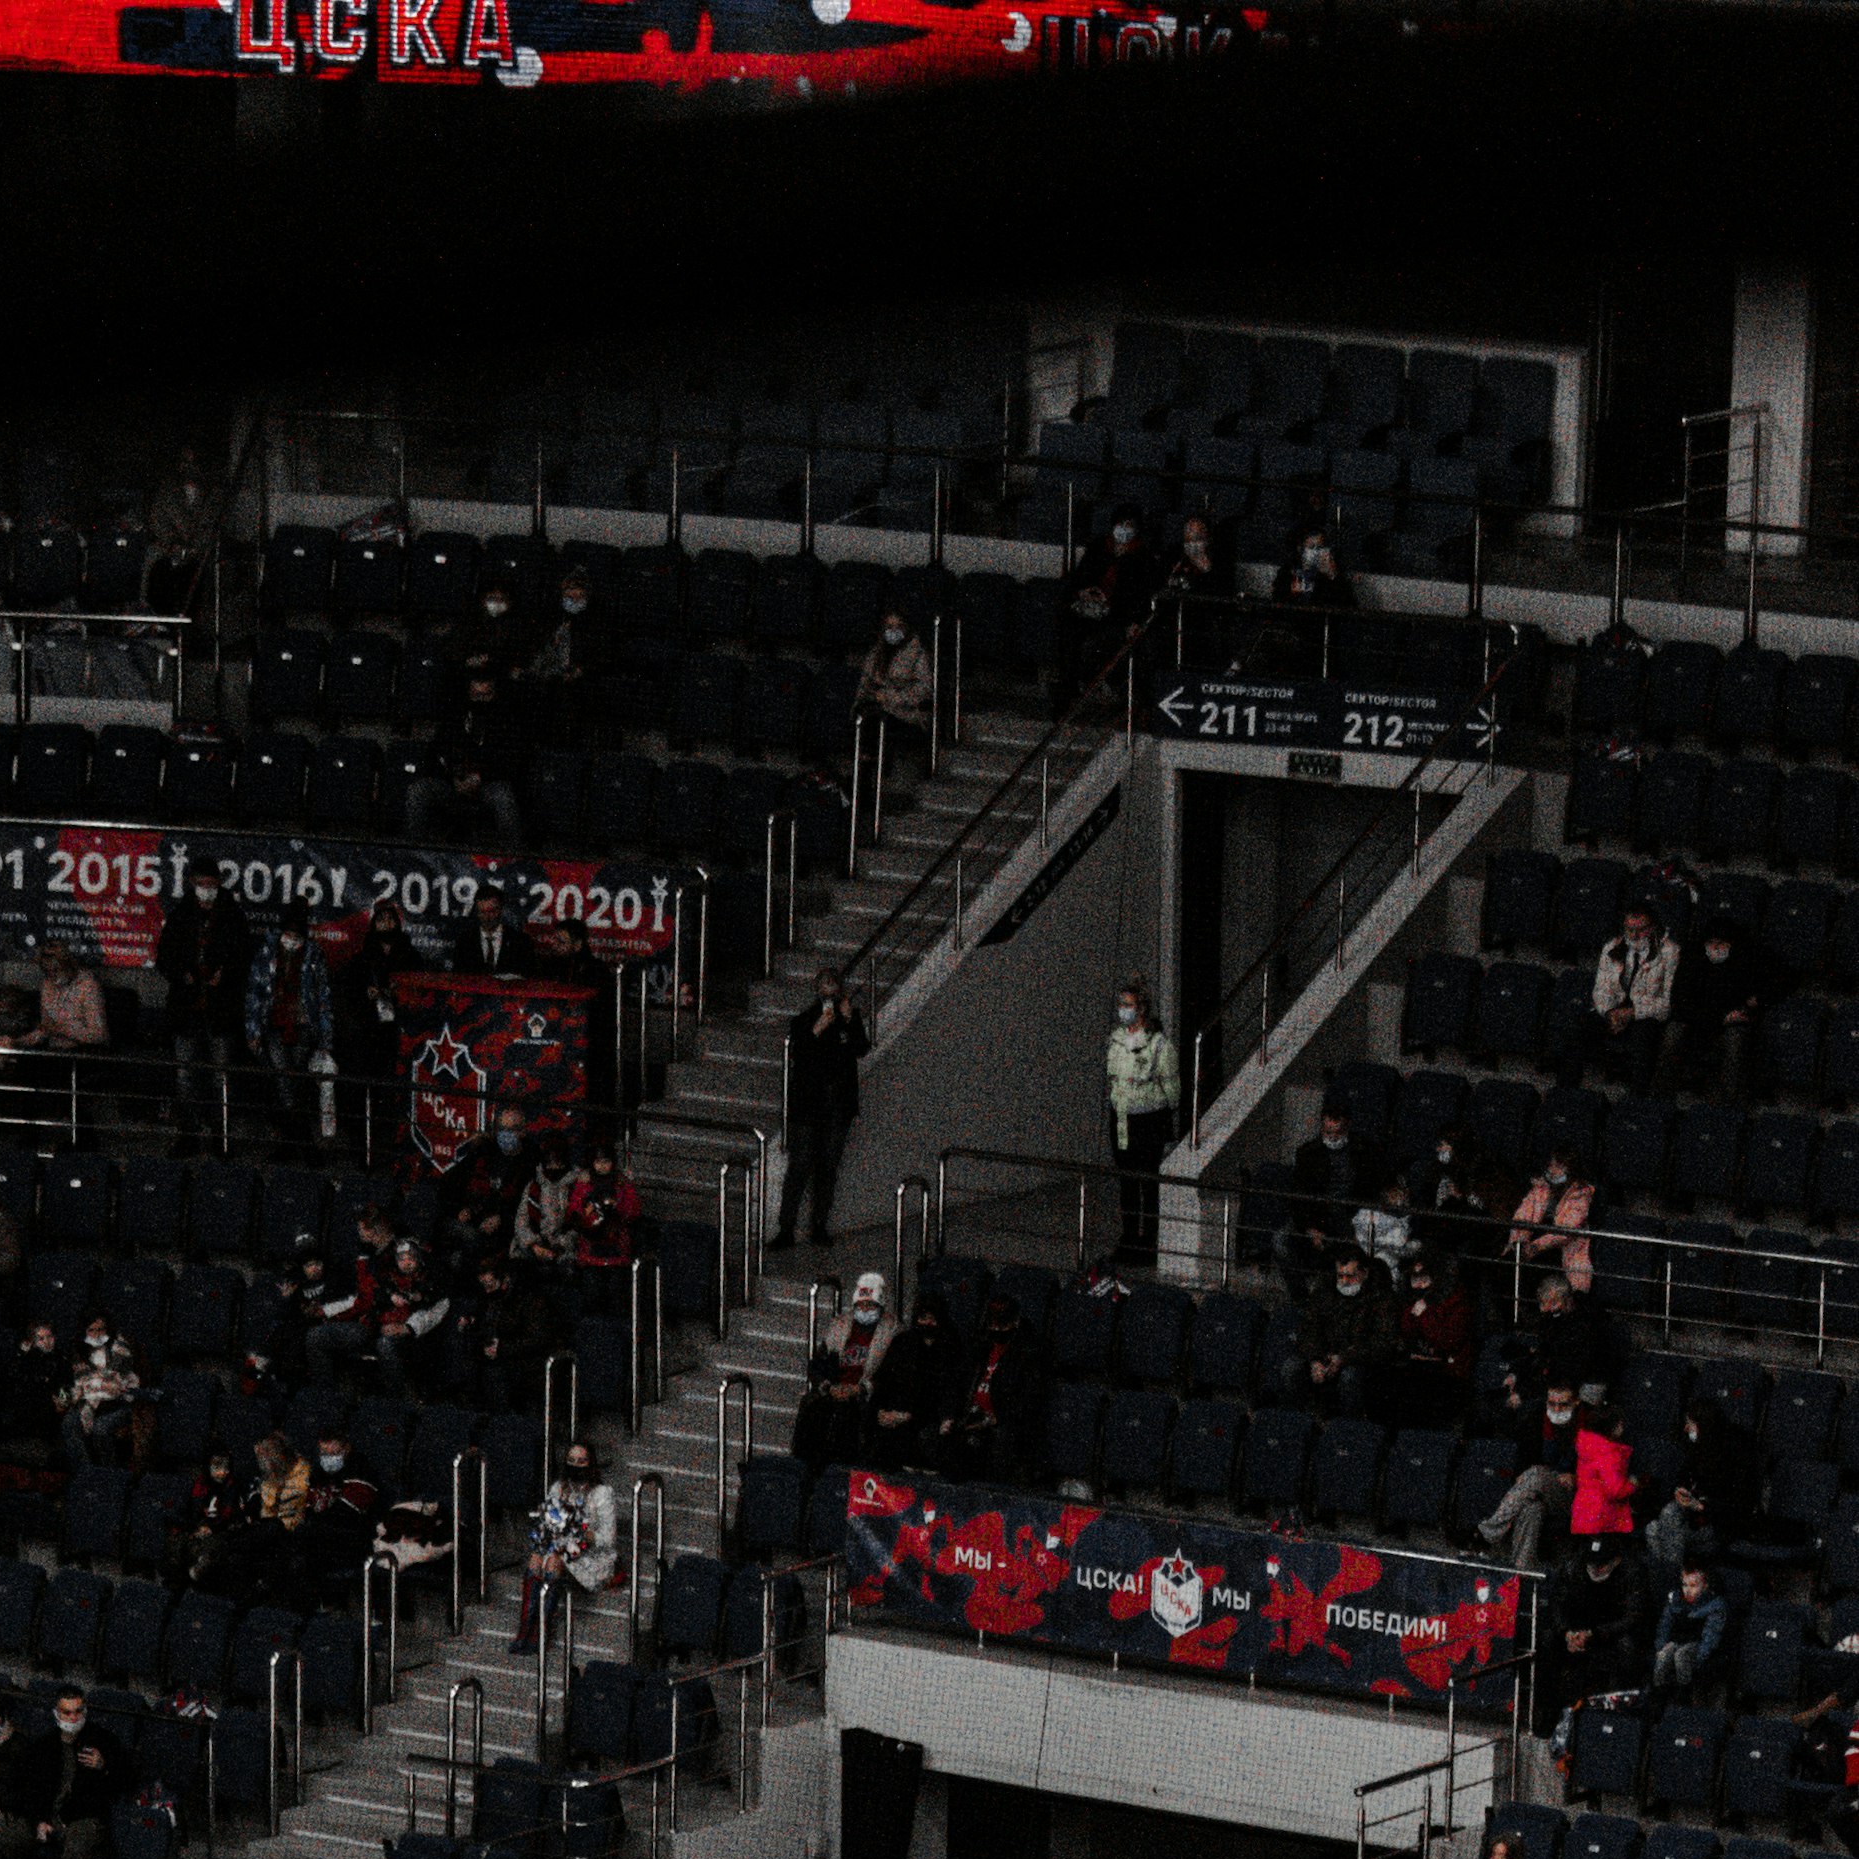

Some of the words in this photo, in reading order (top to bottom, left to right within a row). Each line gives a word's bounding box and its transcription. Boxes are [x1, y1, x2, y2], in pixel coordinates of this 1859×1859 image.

[236, 0, 516, 75] ЦСКА
[1198, 701, 1258, 738] 211
[1342, 711, 1405, 749] 212
[46, 850, 163, 899] 2015
[216, 859, 324, 907] 2016
[370, 868, 479, 918] 2019
[526, 881, 642, 931] 2020
[954, 1545, 993, 1571] МЫ
[1076, 1565, 1144, 1596] ЦСКА!
[1211, 1585, 1251, 1612] МЫ
[1325, 1602, 1447, 1643] ПОБЕДИМ!
